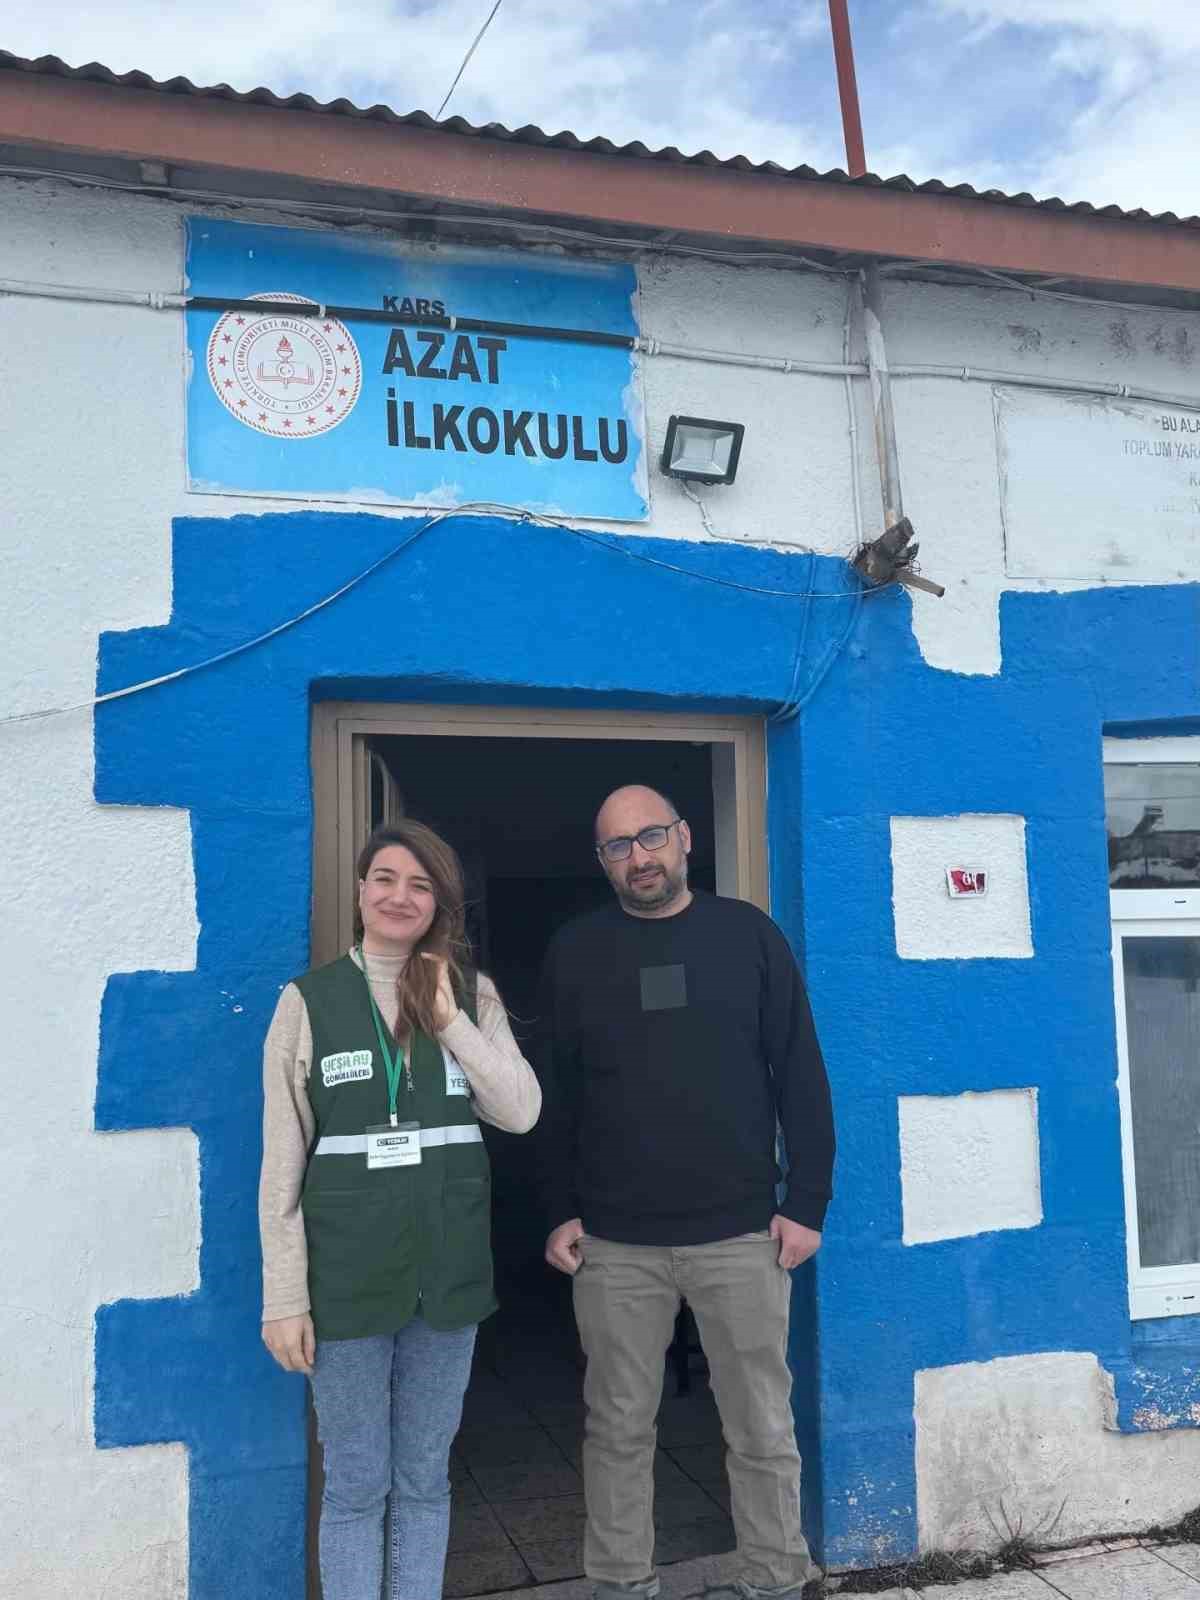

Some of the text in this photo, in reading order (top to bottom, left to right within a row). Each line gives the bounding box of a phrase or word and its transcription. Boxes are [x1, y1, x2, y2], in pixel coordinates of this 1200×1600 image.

[382, 295, 445, 317] KARS
[382, 327, 507, 385] AZAT
[386, 387, 628, 464] İLKOKULU
[1161, 415, 1177, 431] BU
[1122, 440, 1171, 457] TOPLUM
